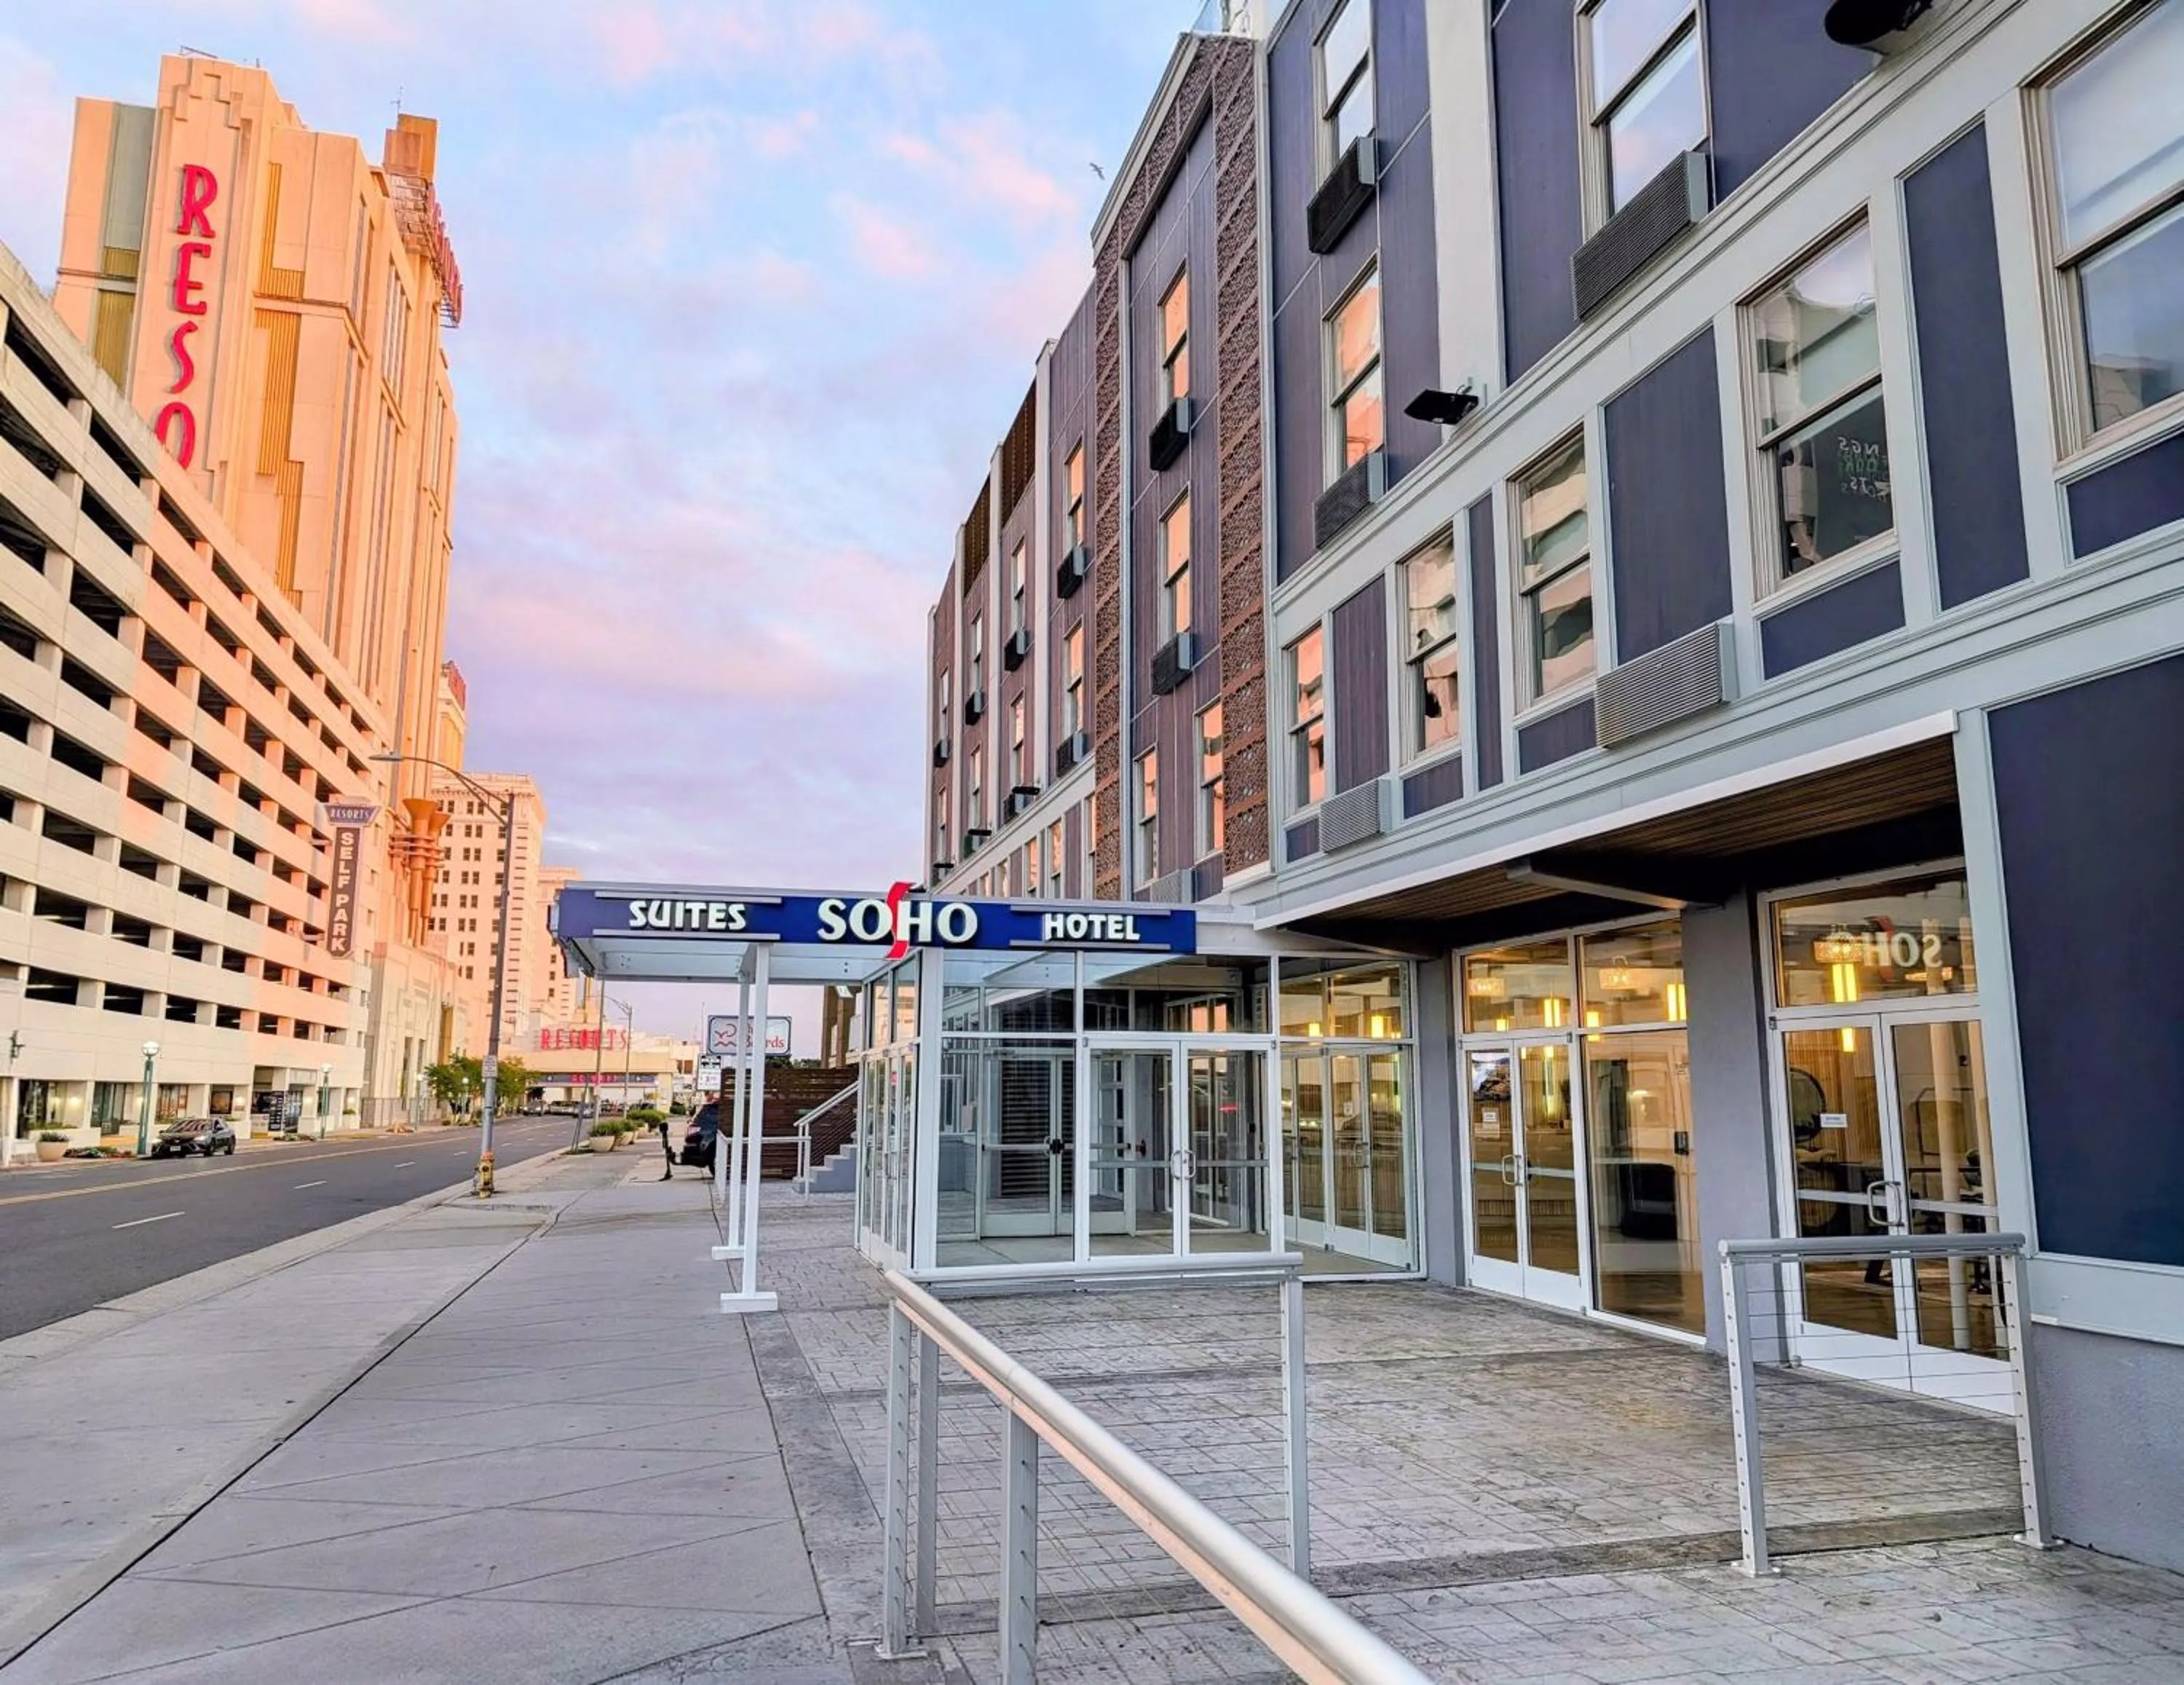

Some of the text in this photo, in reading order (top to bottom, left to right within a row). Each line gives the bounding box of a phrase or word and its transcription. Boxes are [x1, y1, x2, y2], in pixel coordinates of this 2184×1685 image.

[331, 808, 369, 818] RESORTS
[331, 832, 354, 951] SELF PARK
[628, 899, 1140, 944] SUITES SOHO HOTEL
